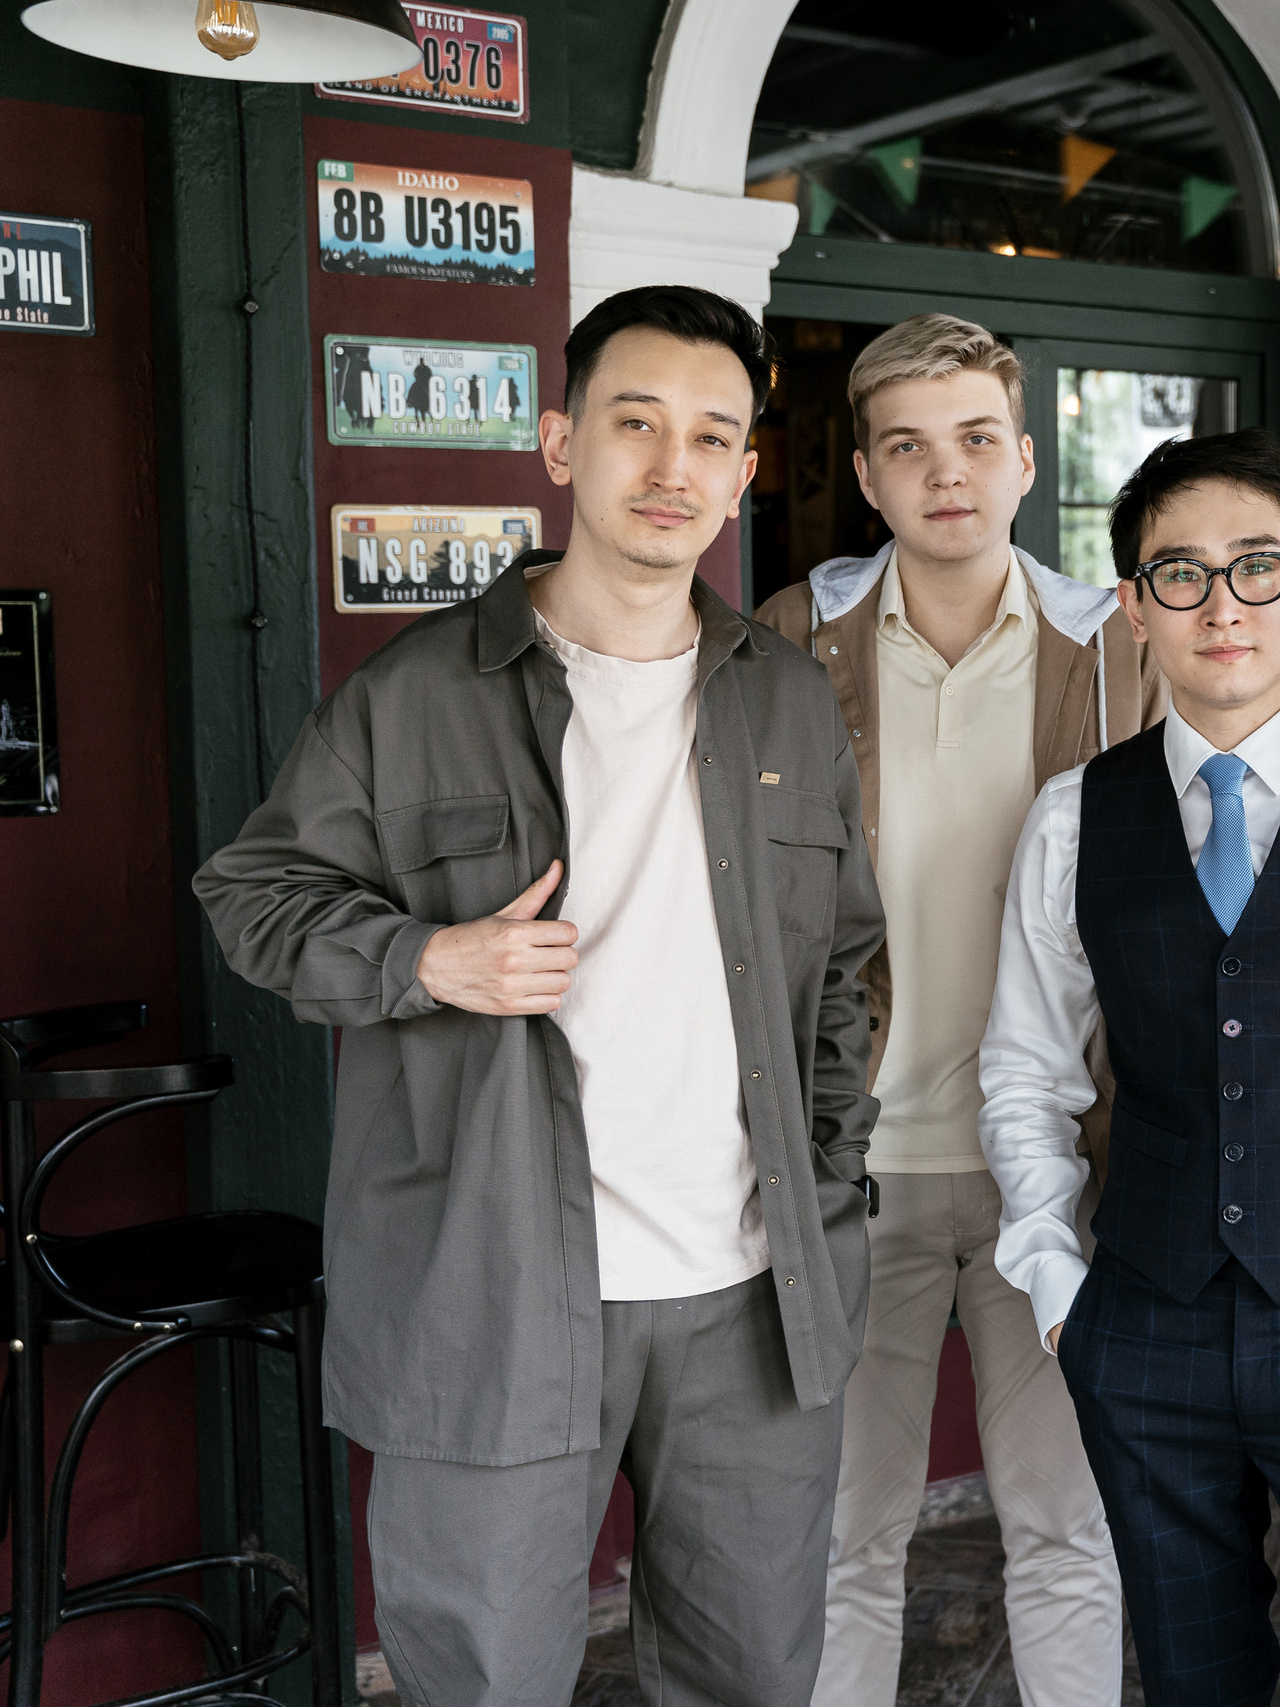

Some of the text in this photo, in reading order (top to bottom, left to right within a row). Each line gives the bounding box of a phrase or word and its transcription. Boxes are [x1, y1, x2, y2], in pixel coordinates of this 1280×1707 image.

[416, 11, 464, 34] MEXICO
[422, 35, 503, 92] 0376
[380, 84, 398, 93] OF
[405, 86, 507, 108] ENCHANTMENT
[397, 170, 460, 191] IDAHO
[333, 188, 522, 256] 8B U3195
[386, 263, 476, 279] FAMOUS POTATOES
[16, 306, 49, 324] State
[402, 349, 465, 369] WYOMING
[360, 370, 513, 423] NB 6314
[392, 419, 482, 437] COWBOY STATE
[412, 517, 466, 533] ARIZONA
[358, 537, 429, 585] NSG
[382, 586, 419, 601] Grand
[422, 586, 467, 603] Canyon
